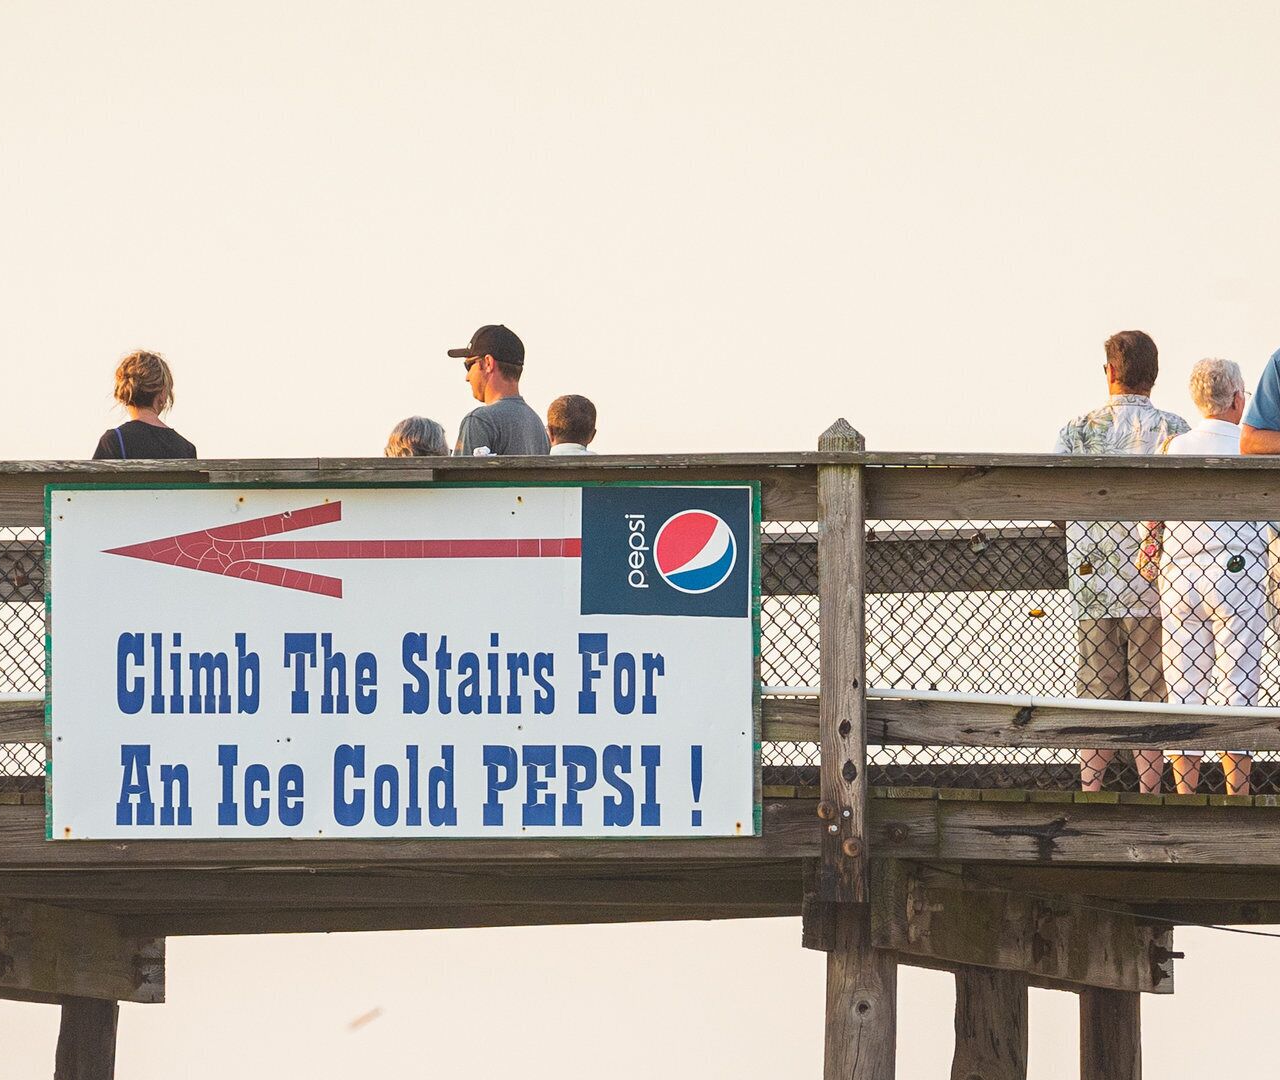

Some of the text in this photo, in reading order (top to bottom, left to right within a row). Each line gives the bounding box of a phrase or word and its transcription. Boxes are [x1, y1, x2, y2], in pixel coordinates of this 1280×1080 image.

[624, 513, 650, 588] pepsi
[116, 632, 665, 715] Climb The Stairs For
[115, 744, 193, 827] An
[217, 743, 305, 827] Ice
[333, 743, 458, 827] Cold
[482, 744, 661, 828] PEPSI
